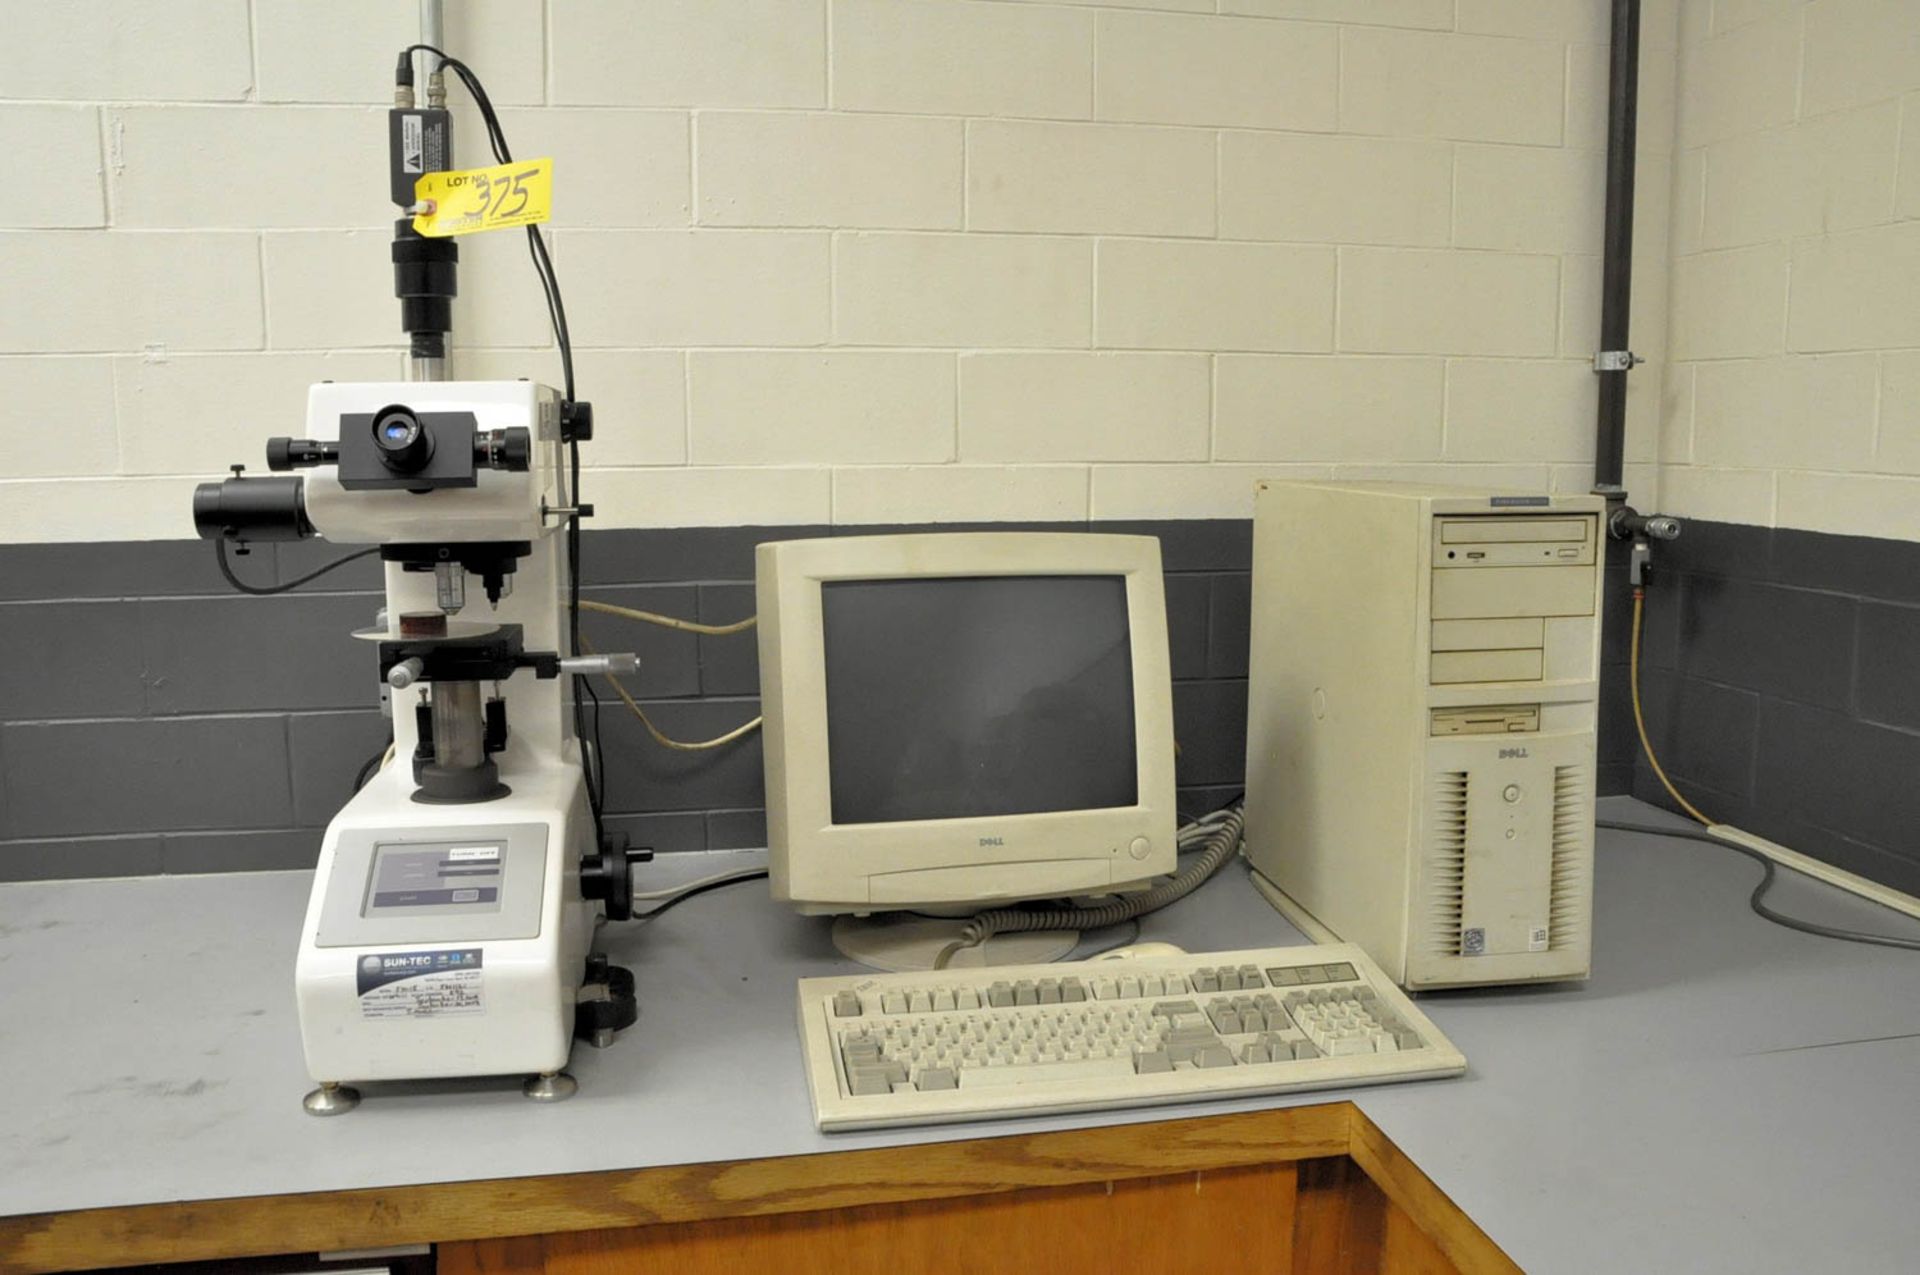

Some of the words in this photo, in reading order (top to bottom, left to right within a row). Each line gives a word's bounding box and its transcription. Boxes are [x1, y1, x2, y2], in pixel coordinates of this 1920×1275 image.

[447, 176, 468, 187] LOT
[463, 168, 539, 217] 375
[1498, 748, 1528, 759] DELL
[979, 838, 1004, 847] DELL
[383, 956, 432, 968] SUN-TEC
